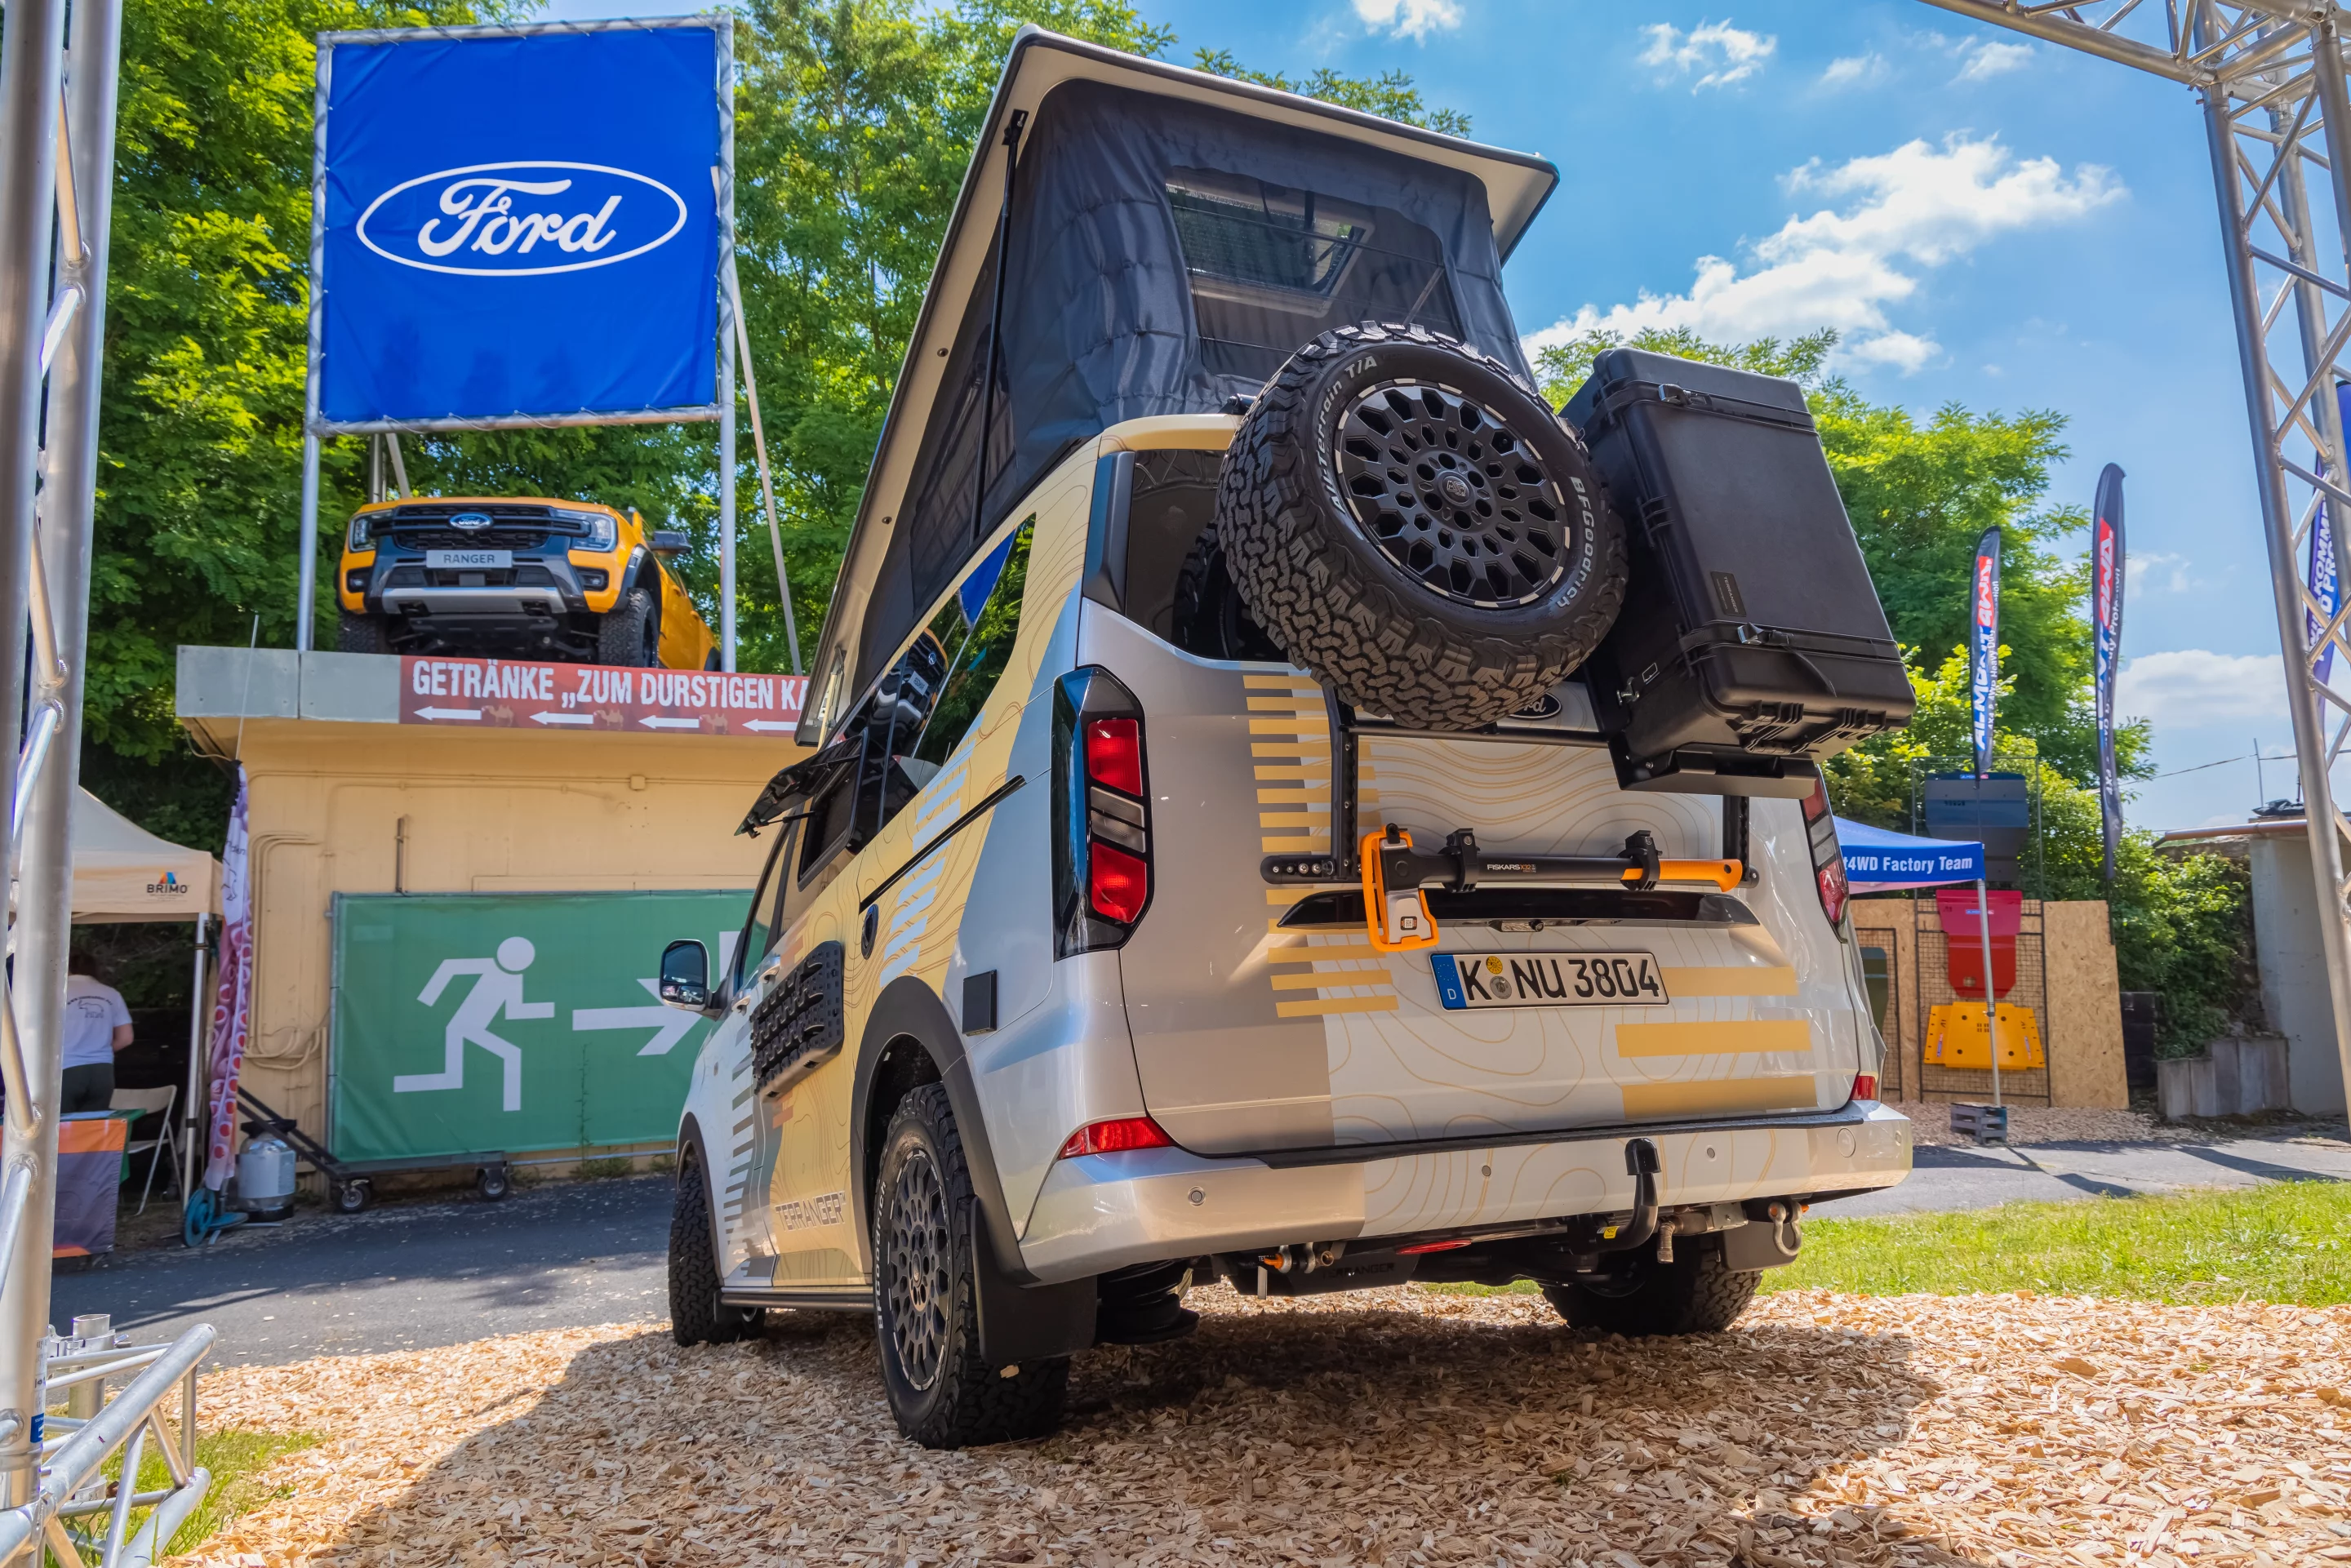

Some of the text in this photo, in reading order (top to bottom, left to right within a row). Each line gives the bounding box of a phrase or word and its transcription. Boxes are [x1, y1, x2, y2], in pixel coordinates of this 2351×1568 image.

[417, 178, 623, 257] Ford
[1344, 355, 1378, 380] T/A
[458, 516, 480, 526] Ford
[1556, 476, 1595, 608] BFGoodrich
[443, 553, 496, 564] RANGER
[1989, 650, 1998, 677] Heavy
[412, 659, 554, 701] GETRÄNKE
[640, 673, 774, 710] DURSTIGEN
[1523, 696, 1547, 713] rd
[1882, 857, 1935, 874] Factory
[1939, 856, 1973, 871] Team
[146, 883, 189, 894] BRIMO
[1459, 958, 1660, 1001] K NU 3804
[1447, 988, 1457, 1000] D
[874, 1180, 887, 1330] BFGoodrich
